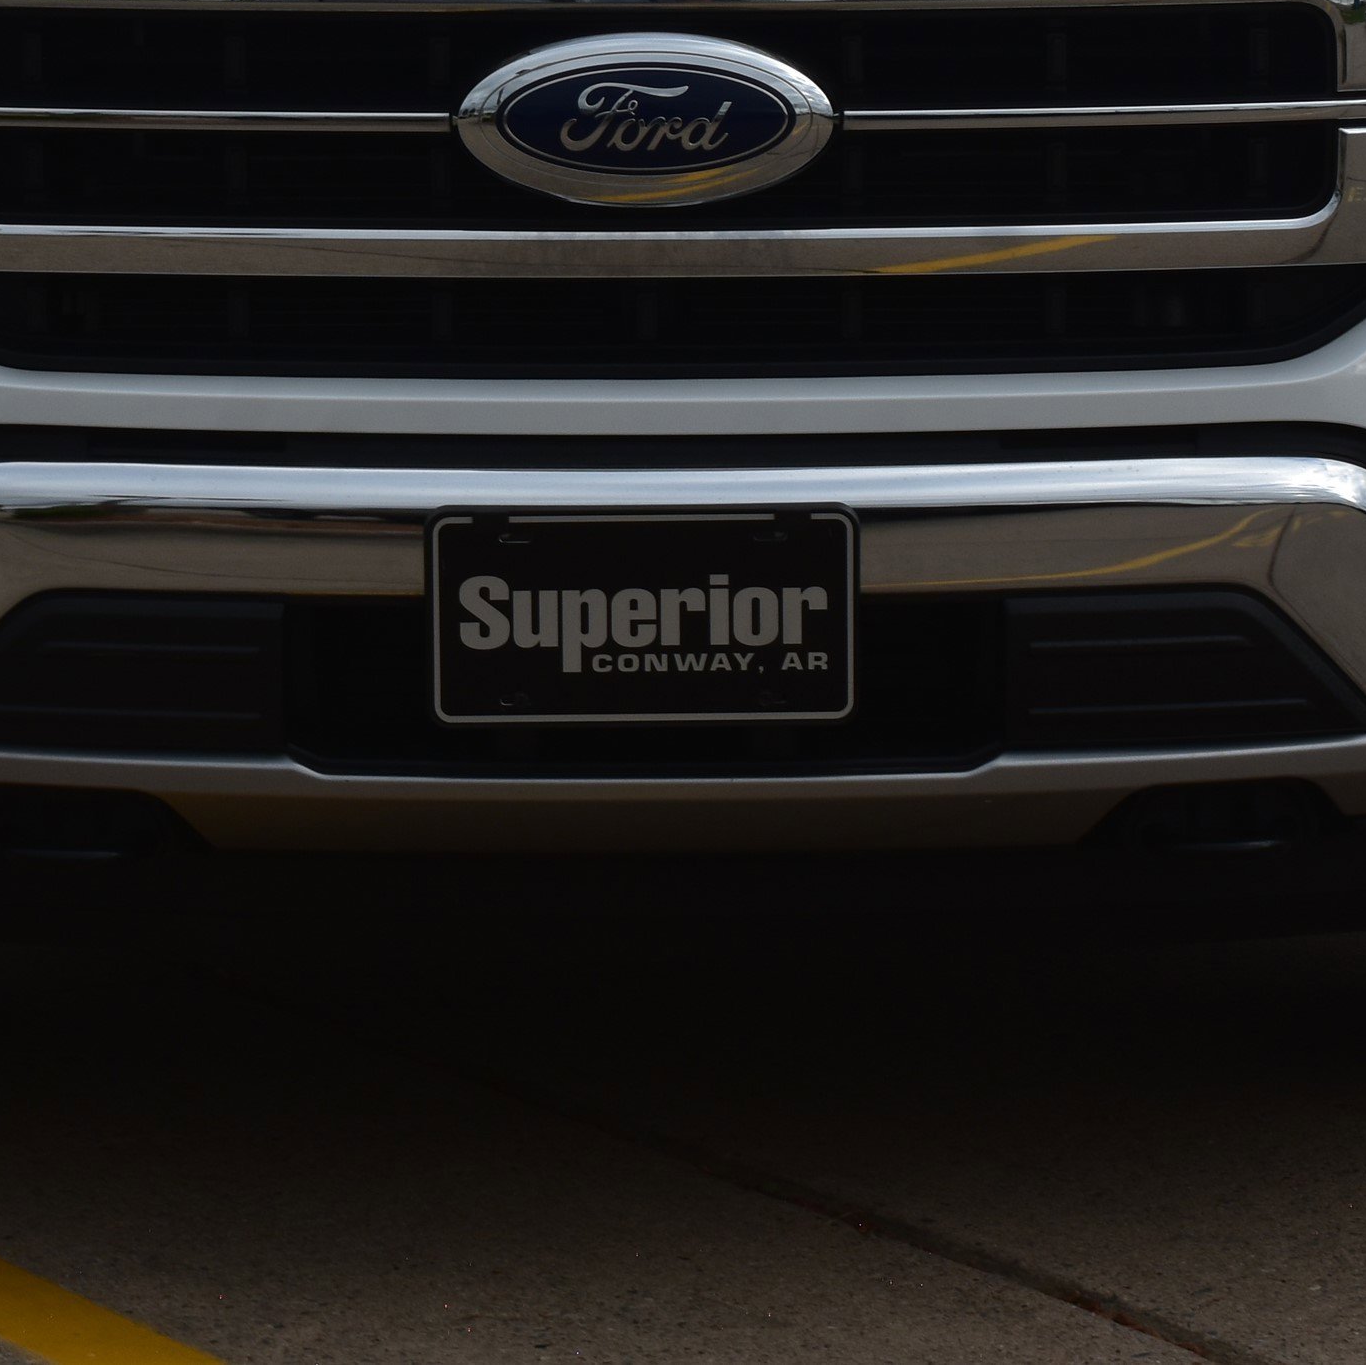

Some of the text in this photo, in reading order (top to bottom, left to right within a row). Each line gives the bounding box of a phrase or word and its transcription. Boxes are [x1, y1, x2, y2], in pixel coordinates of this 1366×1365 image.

[560, 81, 733, 152] Ford
[458, 574, 828, 673] Superior
[591, 652, 829, 674] CONWAY, AR
